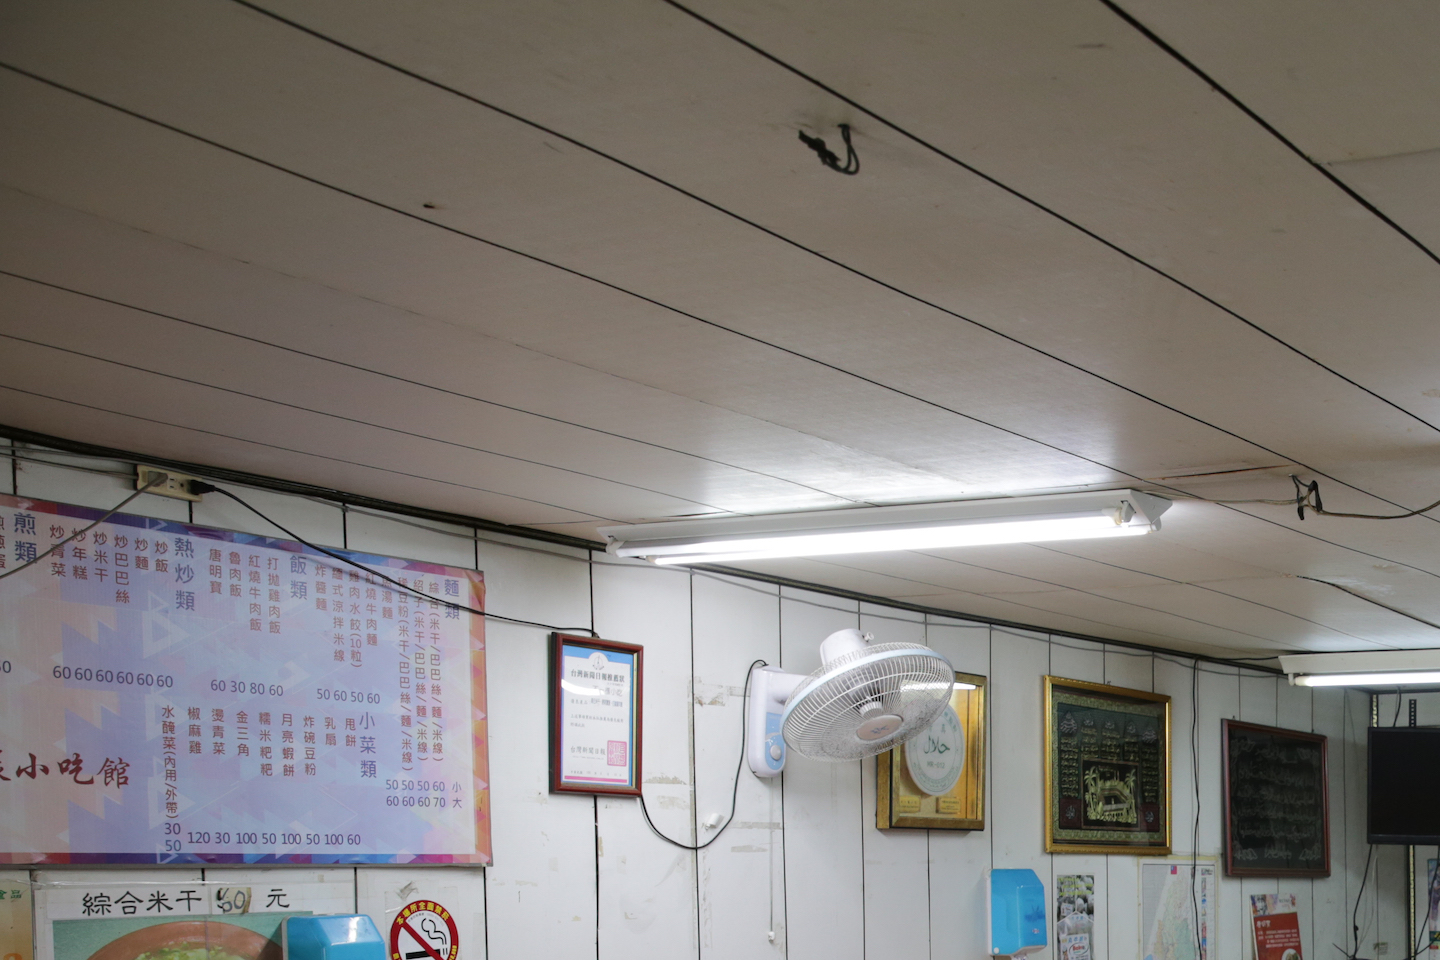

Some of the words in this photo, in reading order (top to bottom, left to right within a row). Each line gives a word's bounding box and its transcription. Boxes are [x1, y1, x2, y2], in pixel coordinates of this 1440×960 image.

[14, 512, 37, 564] 煎類
[50, 524, 66, 578] 炒青菜
[71, 527, 88, 580] 炒年糕
[93, 531, 108, 582] 炒米干
[134, 537, 149, 571] 炒麵
[154, 540, 169, 573] 炒飯
[114, 534, 130, 604] 炒巴巴絲
[174, 537, 195, 612] 熱炒類
[229, 551, 242, 598] 魯肉飯
[290, 555, 307, 600] 飯類
[314, 564, 327, 612] 炸醬麵
[248, 554, 262, 632] 紅燒牛肉飯
[267, 557, 281, 635] 打拋雞肉飯
[365, 572, 378, 647] 紅燒牛肉麵
[444, 578, 460, 620] 麵類
[0, 660, 12, 673] 0
[53, 665, 71, 681] 60
[74, 667, 92, 682] 60
[95, 668, 114, 684] 60
[116, 669, 134, 685] 60
[136, 671, 154, 687] 60
[156, 673, 173, 689] 60
[210, 679, 226, 692] 60
[230, 681, 246, 693] 30
[250, 682, 265, 695] 80
[269, 684, 284, 696] 60
[317, 688, 331, 700] 50
[333, 690, 347, 701] 60
[351, 691, 364, 703] 50
[367, 693, 380, 704] 60
[187, 707, 202, 755] 椒麻雞
[211, 708, 226, 755] 燙青菜
[236, 710, 249, 757] 金三角
[259, 711, 273, 777] 糯米粑粑
[281, 713, 295, 777] 月亮蝦餅
[324, 716, 337, 746] 乳扇
[359, 711, 377, 778] 小菜類
[386, 779, 399, 790] 50
[402, 780, 414, 791] 50
[417, 780, 430, 791] 50
[432, 781, 445, 792] 60
[452, 781, 462, 793] 小
[386, 795, 399, 806] 60
[402, 795, 415, 807] 60
[418, 796, 430, 807] 60
[433, 797, 446, 808] 70
[453, 797, 462, 808] 大
[164, 823, 181, 835] 30
[165, 840, 182, 852] 50
[187, 832, 211, 844] 120
[215, 832, 231, 844] 30
[236, 832, 257, 845] 100
[262, 833, 277, 845] 50
[281, 833, 302, 845] 100
[306, 833, 320, 845] 50
[324, 834, 344, 845] 100
[347, 834, 361, 845] 60
[82, 890, 202, 917] 綜合米干
[266, 888, 290, 909] 元
